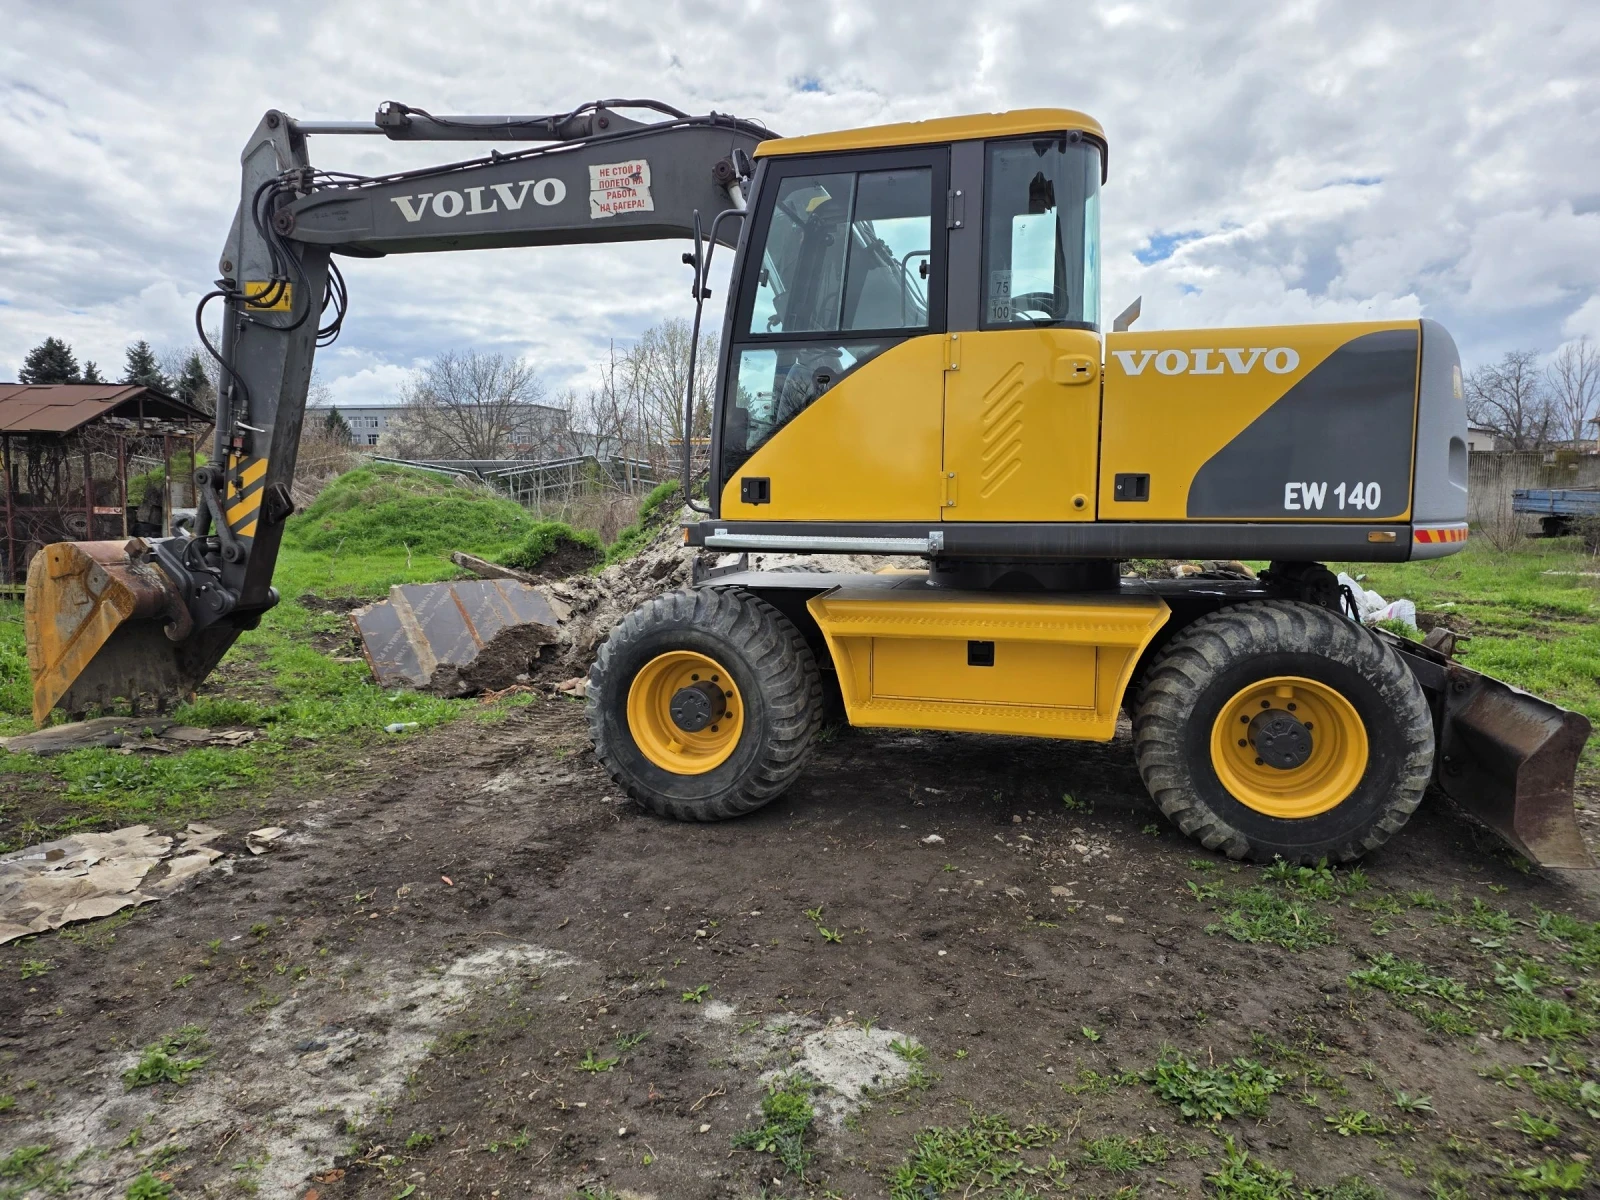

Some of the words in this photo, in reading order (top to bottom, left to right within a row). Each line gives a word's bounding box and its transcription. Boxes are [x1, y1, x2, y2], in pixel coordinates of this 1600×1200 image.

[600, 168, 610, 177] НЕ
[612, 165, 634, 176] СТОЙ
[599, 177, 630, 189] ПОЛЕТО
[632, 176, 643, 185] НА
[390, 177, 567, 223] VOLVO
[606, 189, 637, 200] РАБОТА
[600, 203, 610, 213] НА
[613, 199, 645, 211] БАГЕРА!
[996, 281, 1009, 294] 75
[992, 306, 1009, 319] 100
[1111, 347, 1300, 376] VOLVO
[1284, 481, 1328, 511] EW
[1333, 481, 1381, 511] 140
